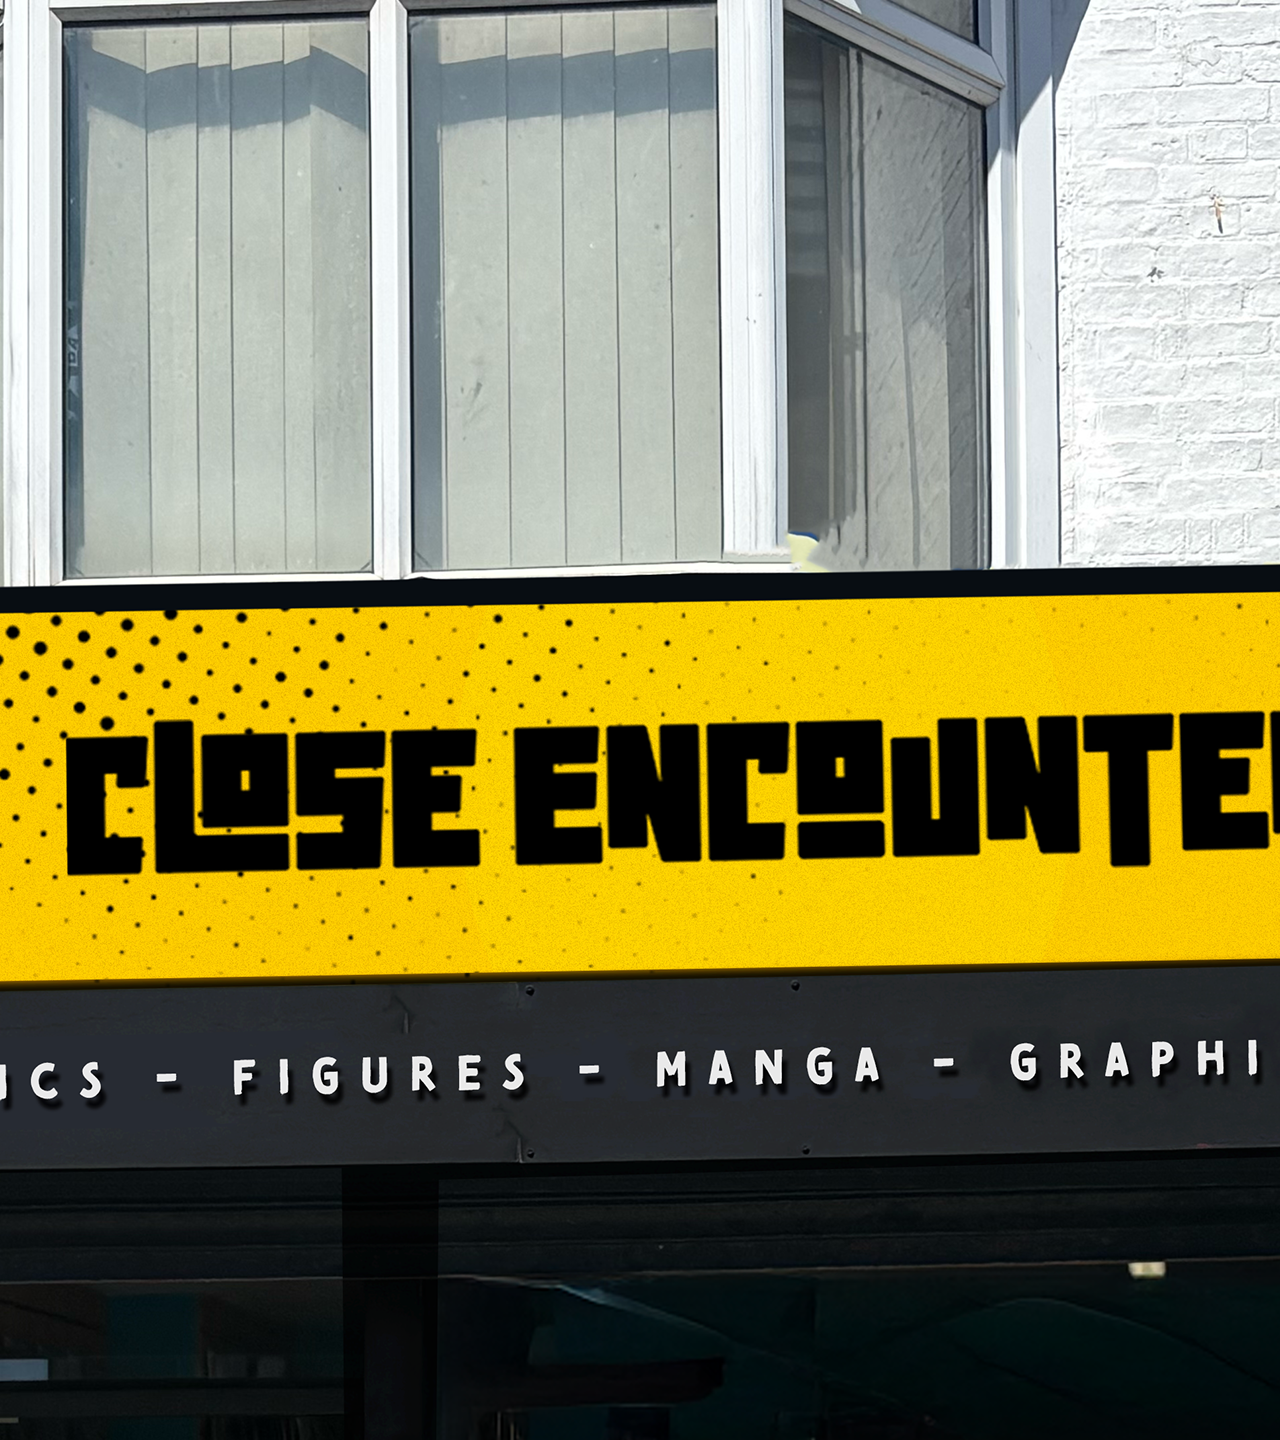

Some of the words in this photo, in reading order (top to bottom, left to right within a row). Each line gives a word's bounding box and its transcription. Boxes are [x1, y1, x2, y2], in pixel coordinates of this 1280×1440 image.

[60, 720, 480, 878] CLOSE
[233, 1053, 524, 1096] FIGURES
[656, 1046, 880, 1088] MANGA
